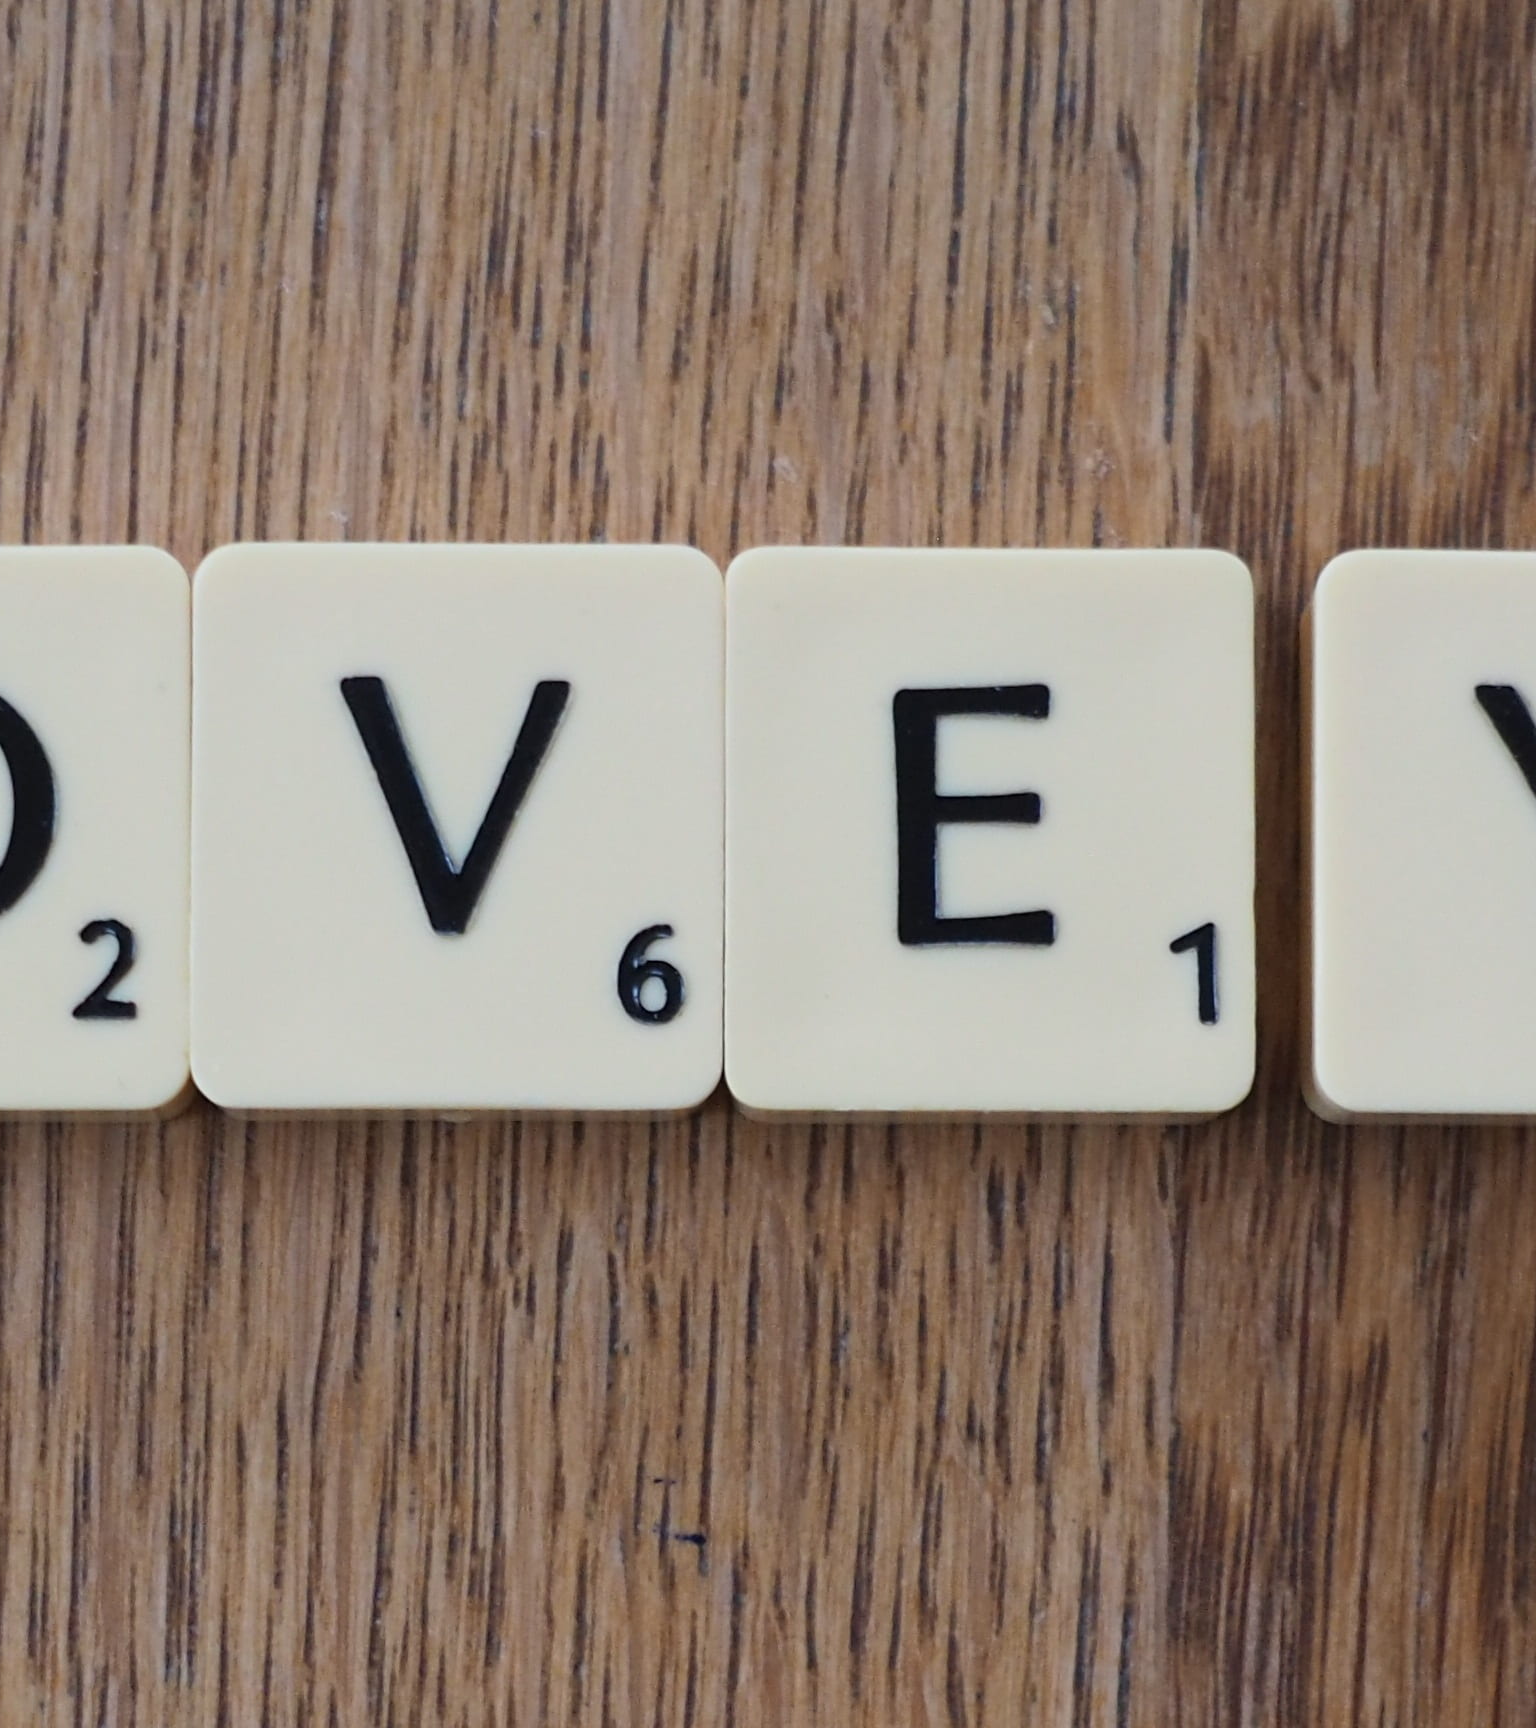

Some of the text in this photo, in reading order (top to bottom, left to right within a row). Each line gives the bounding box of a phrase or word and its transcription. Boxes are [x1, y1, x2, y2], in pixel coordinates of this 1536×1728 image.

[70, 917, 139, 1022] 2
[615, 922, 686, 1026] 6
[1168, 921, 1220, 1026] 1
